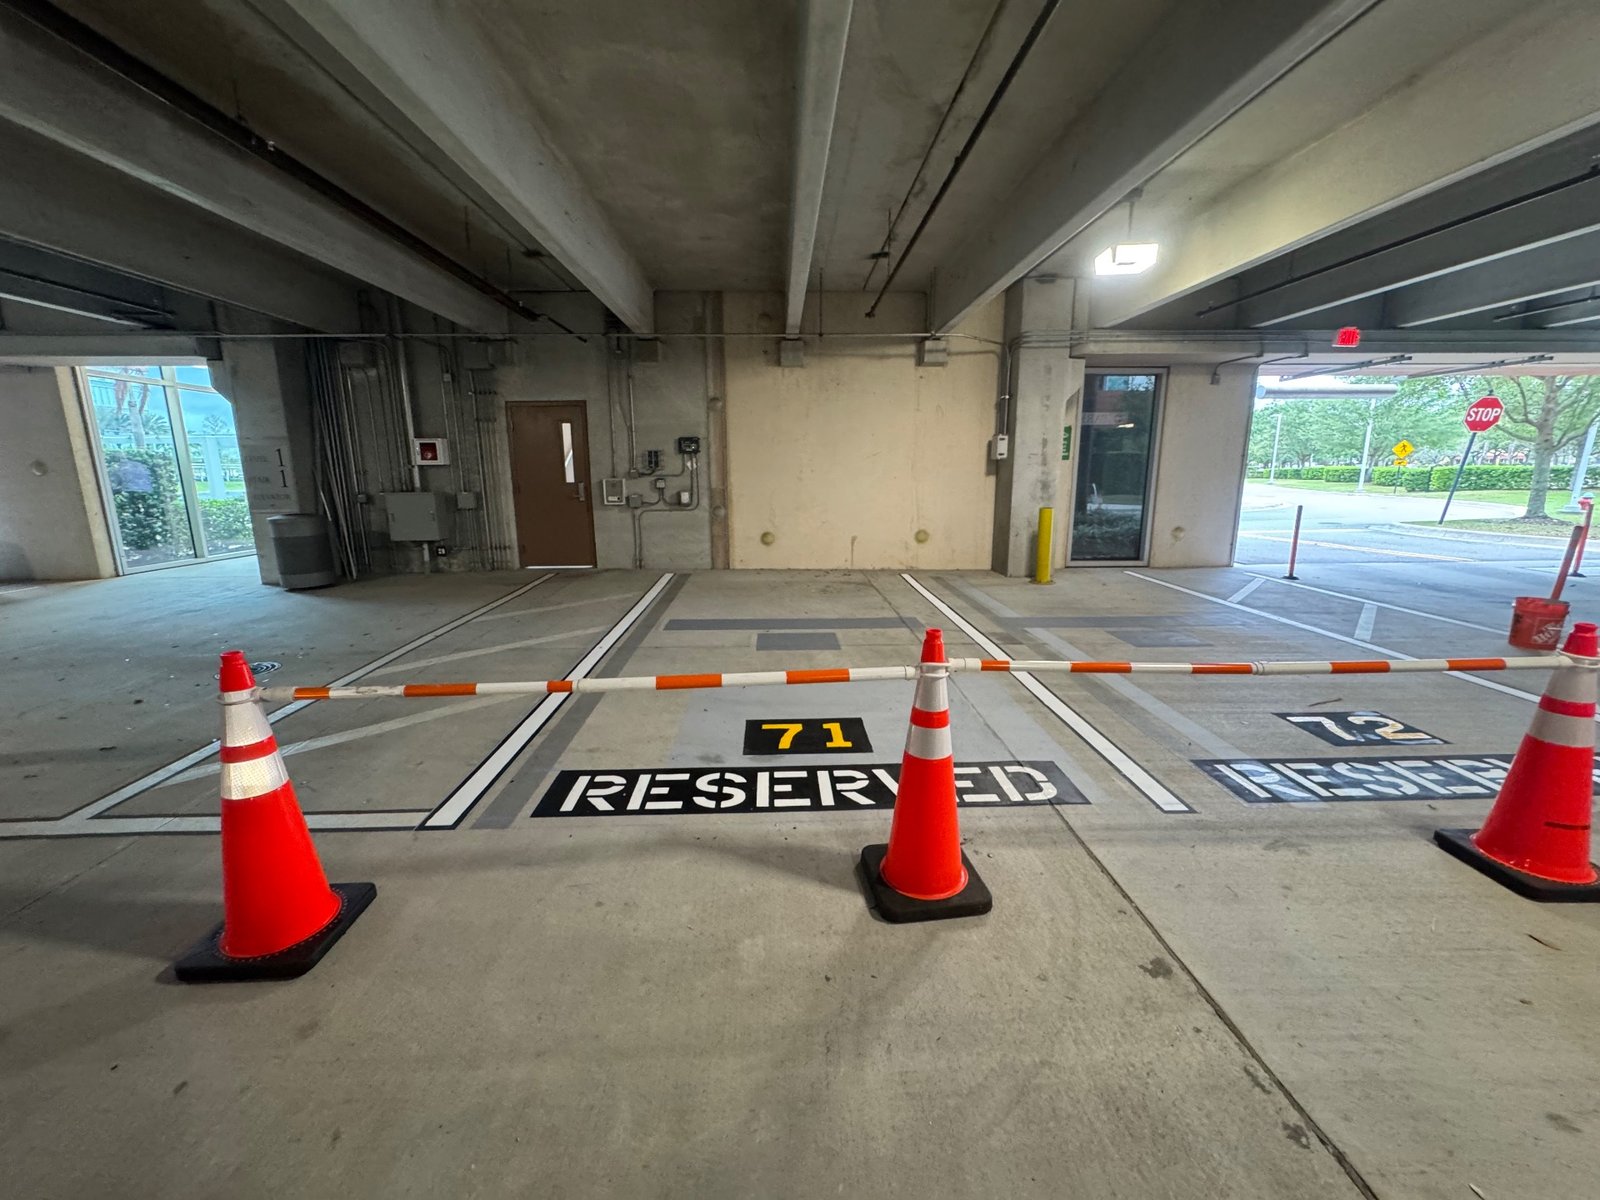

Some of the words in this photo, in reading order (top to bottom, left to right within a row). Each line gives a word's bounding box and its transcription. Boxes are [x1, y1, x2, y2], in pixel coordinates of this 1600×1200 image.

[1467, 407, 1501, 422] STOP
[275, 448, 286, 467] 1
[280, 469, 289, 488] 1
[761, 722, 853, 750] 71
[1285, 716, 1433, 741] 72
[1213, 756, 1600, 799] RESER
